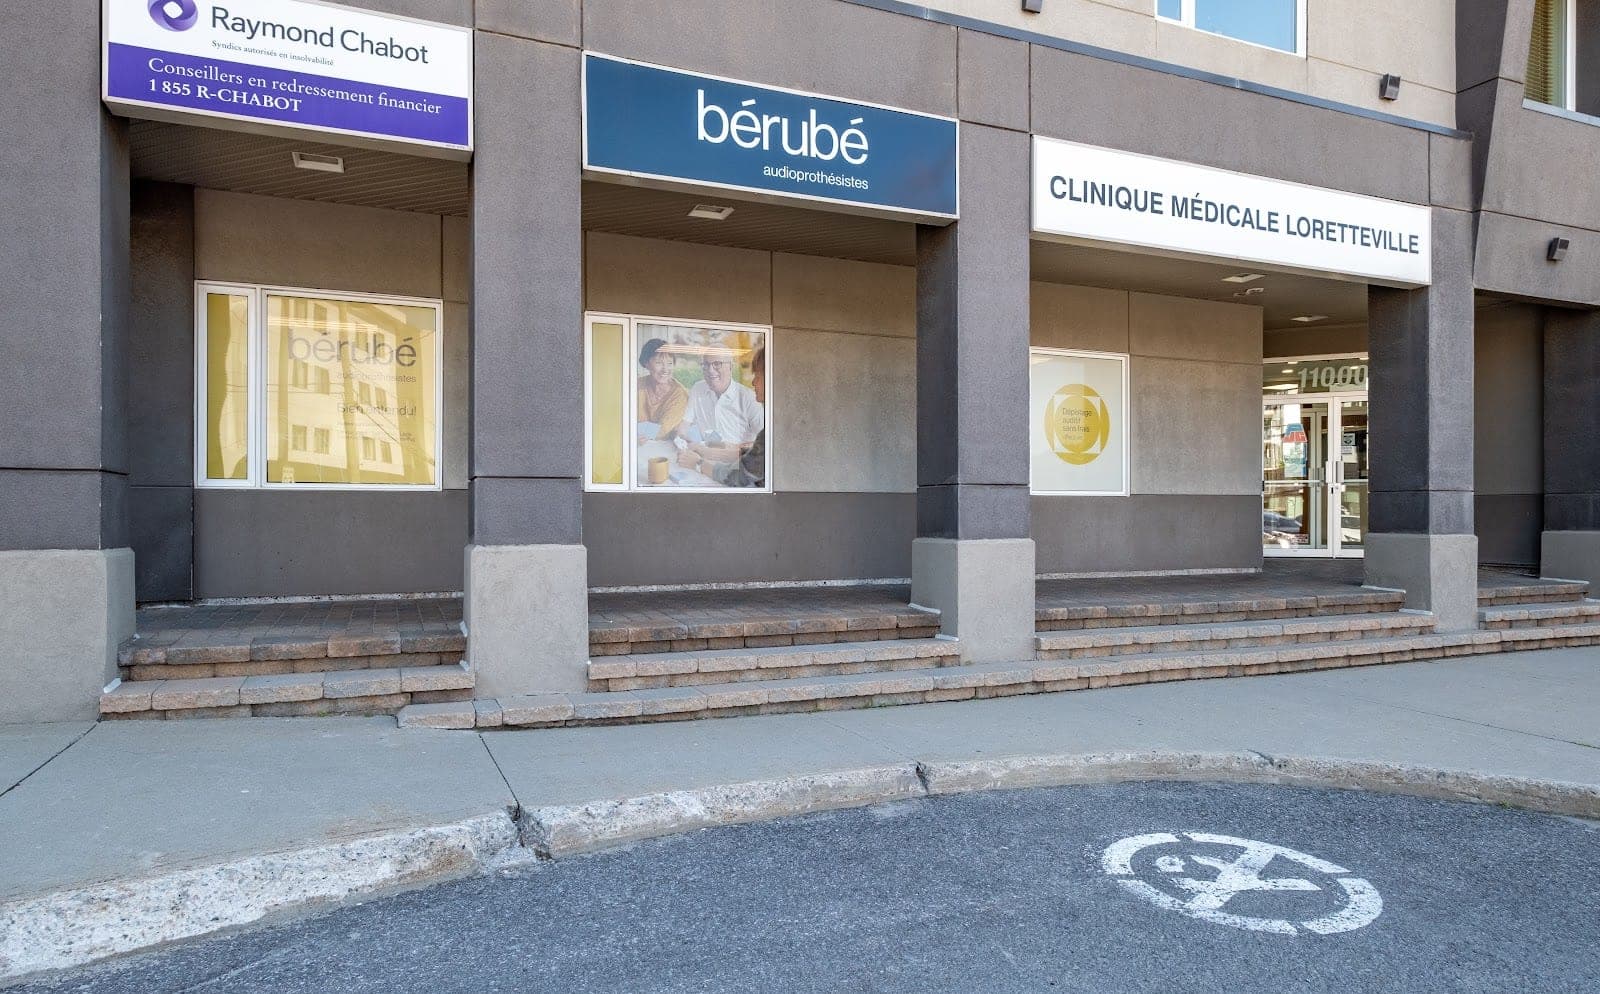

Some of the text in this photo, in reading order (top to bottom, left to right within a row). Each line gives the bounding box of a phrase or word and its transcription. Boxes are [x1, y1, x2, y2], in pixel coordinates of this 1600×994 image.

[211, 6, 430, 64] Raymond Chabot
[211, 39, 242, 51] Syndics
[243, 46, 278, 58] autorisés
[290, 52, 334, 67] insolvabilité
[148, 57, 442, 115] Conseillers en redressement financier
[149, 78, 303, 113] 1 855 R-CHABOT
[697, 88, 869, 166] bérubé
[762, 164, 869, 191] audioprothésistes
[1049, 174, 1420, 255] CLINIQUE MÉDICALE LORETTEVILLE
[288, 328, 417, 368] bérubé
[1298, 364, 1369, 388] 11000
